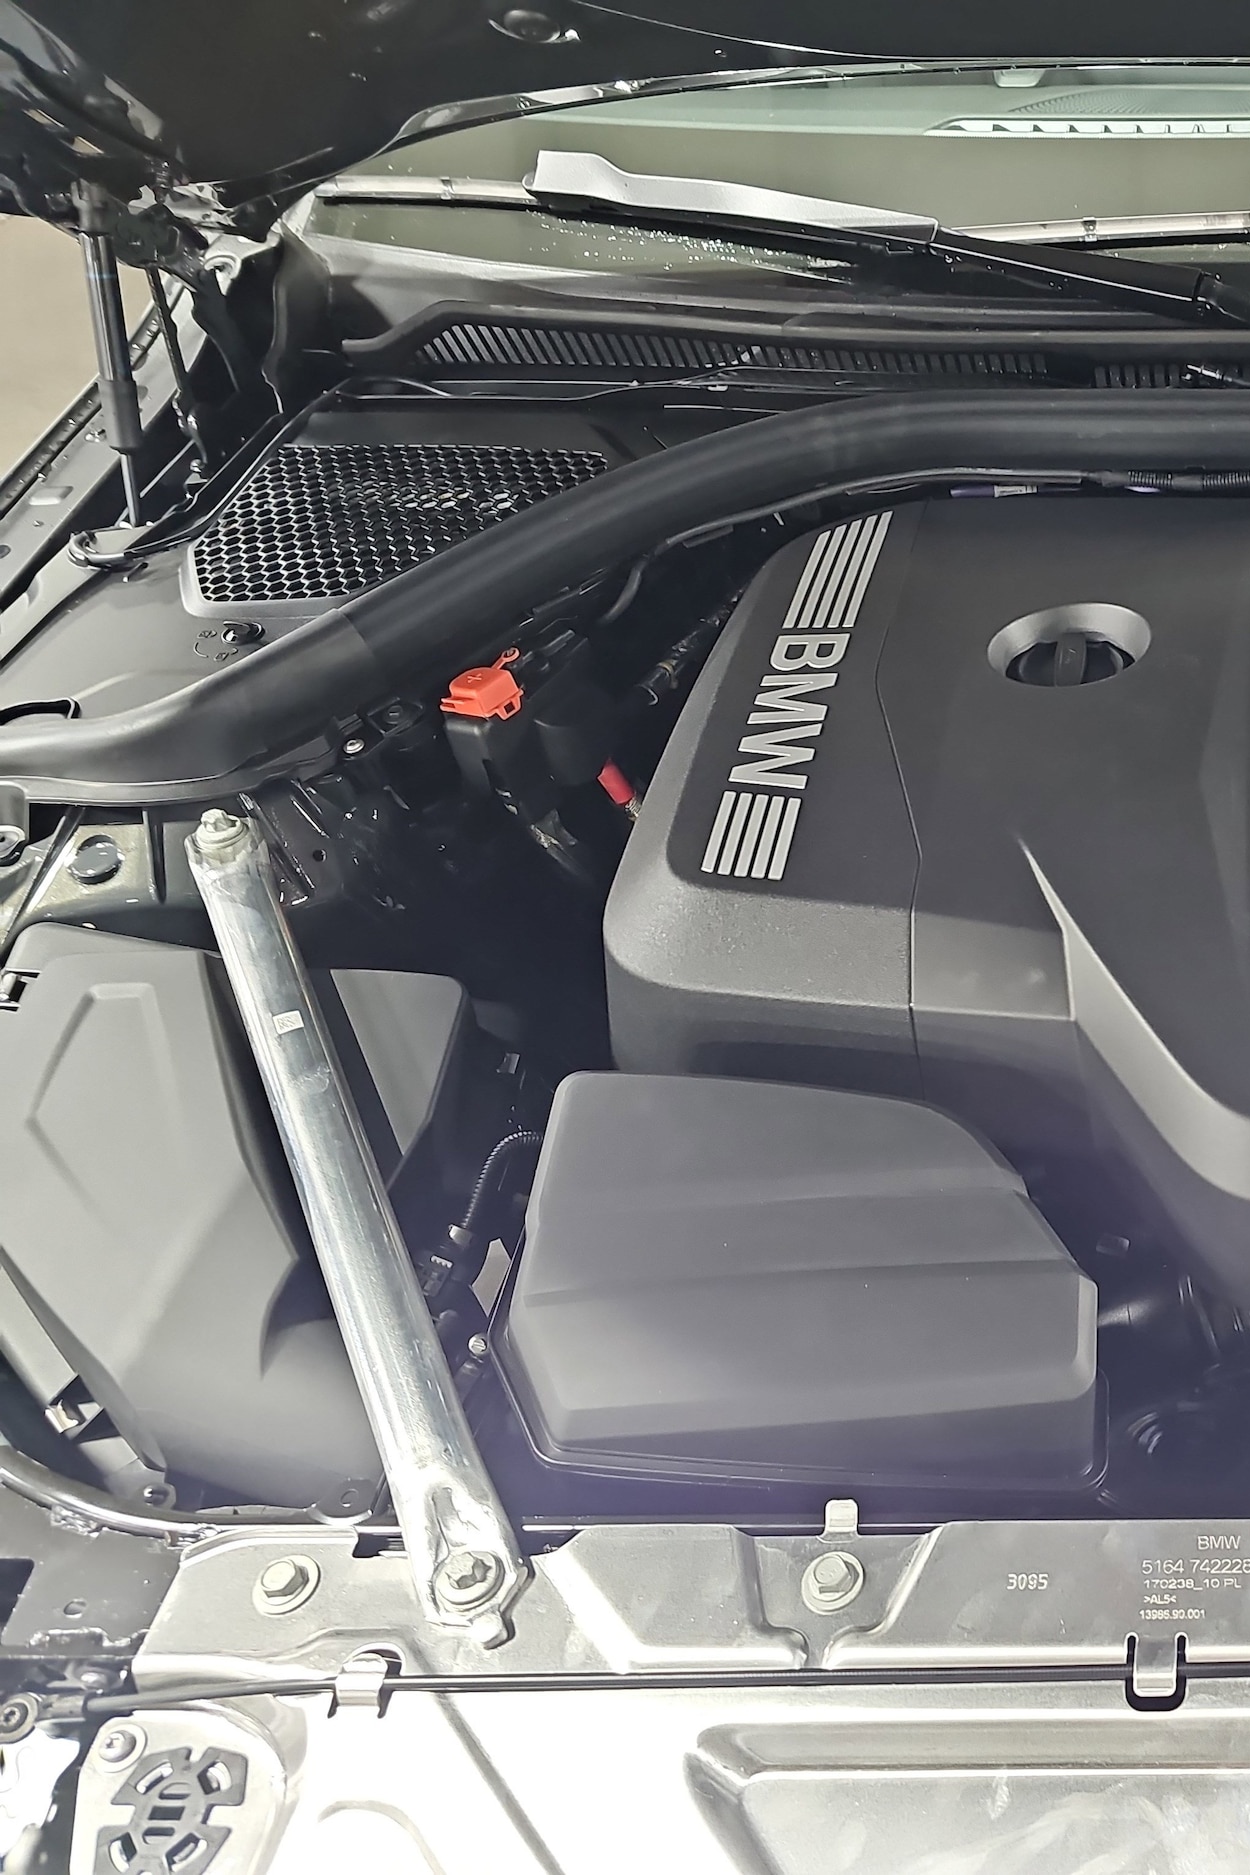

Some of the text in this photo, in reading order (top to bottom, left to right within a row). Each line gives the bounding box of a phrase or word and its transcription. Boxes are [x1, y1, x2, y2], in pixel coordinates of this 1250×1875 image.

[728, 633, 850, 789] BMW
[1197, 1535, 1241, 1550] BMW
[1142, 1559, 1185, 1575] 5164
[1006, 1573, 1049, 1590] 3095
[1143, 1578, 1242, 1590] 170238_10 PL
